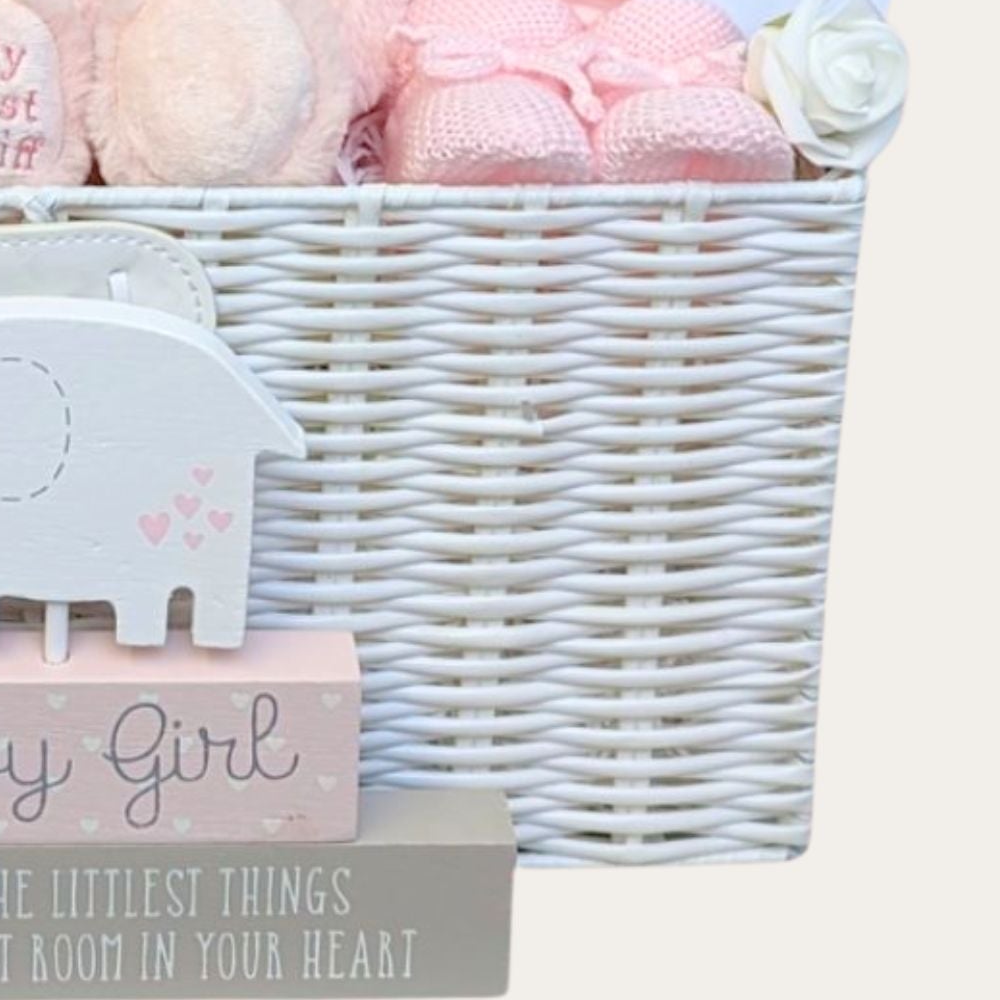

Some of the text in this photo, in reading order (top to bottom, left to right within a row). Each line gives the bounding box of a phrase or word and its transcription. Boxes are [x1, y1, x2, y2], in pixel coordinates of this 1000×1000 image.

[102, 692, 300, 829] Girl
[52, 867, 203, 919] LITTLEST
[219, 866, 352, 917] THINGS
[31, 933, 122, 982] ROOM
[141, 931, 176, 981] IN
[196, 931, 283, 981] YOUR
[303, 929, 417, 980] HEART
